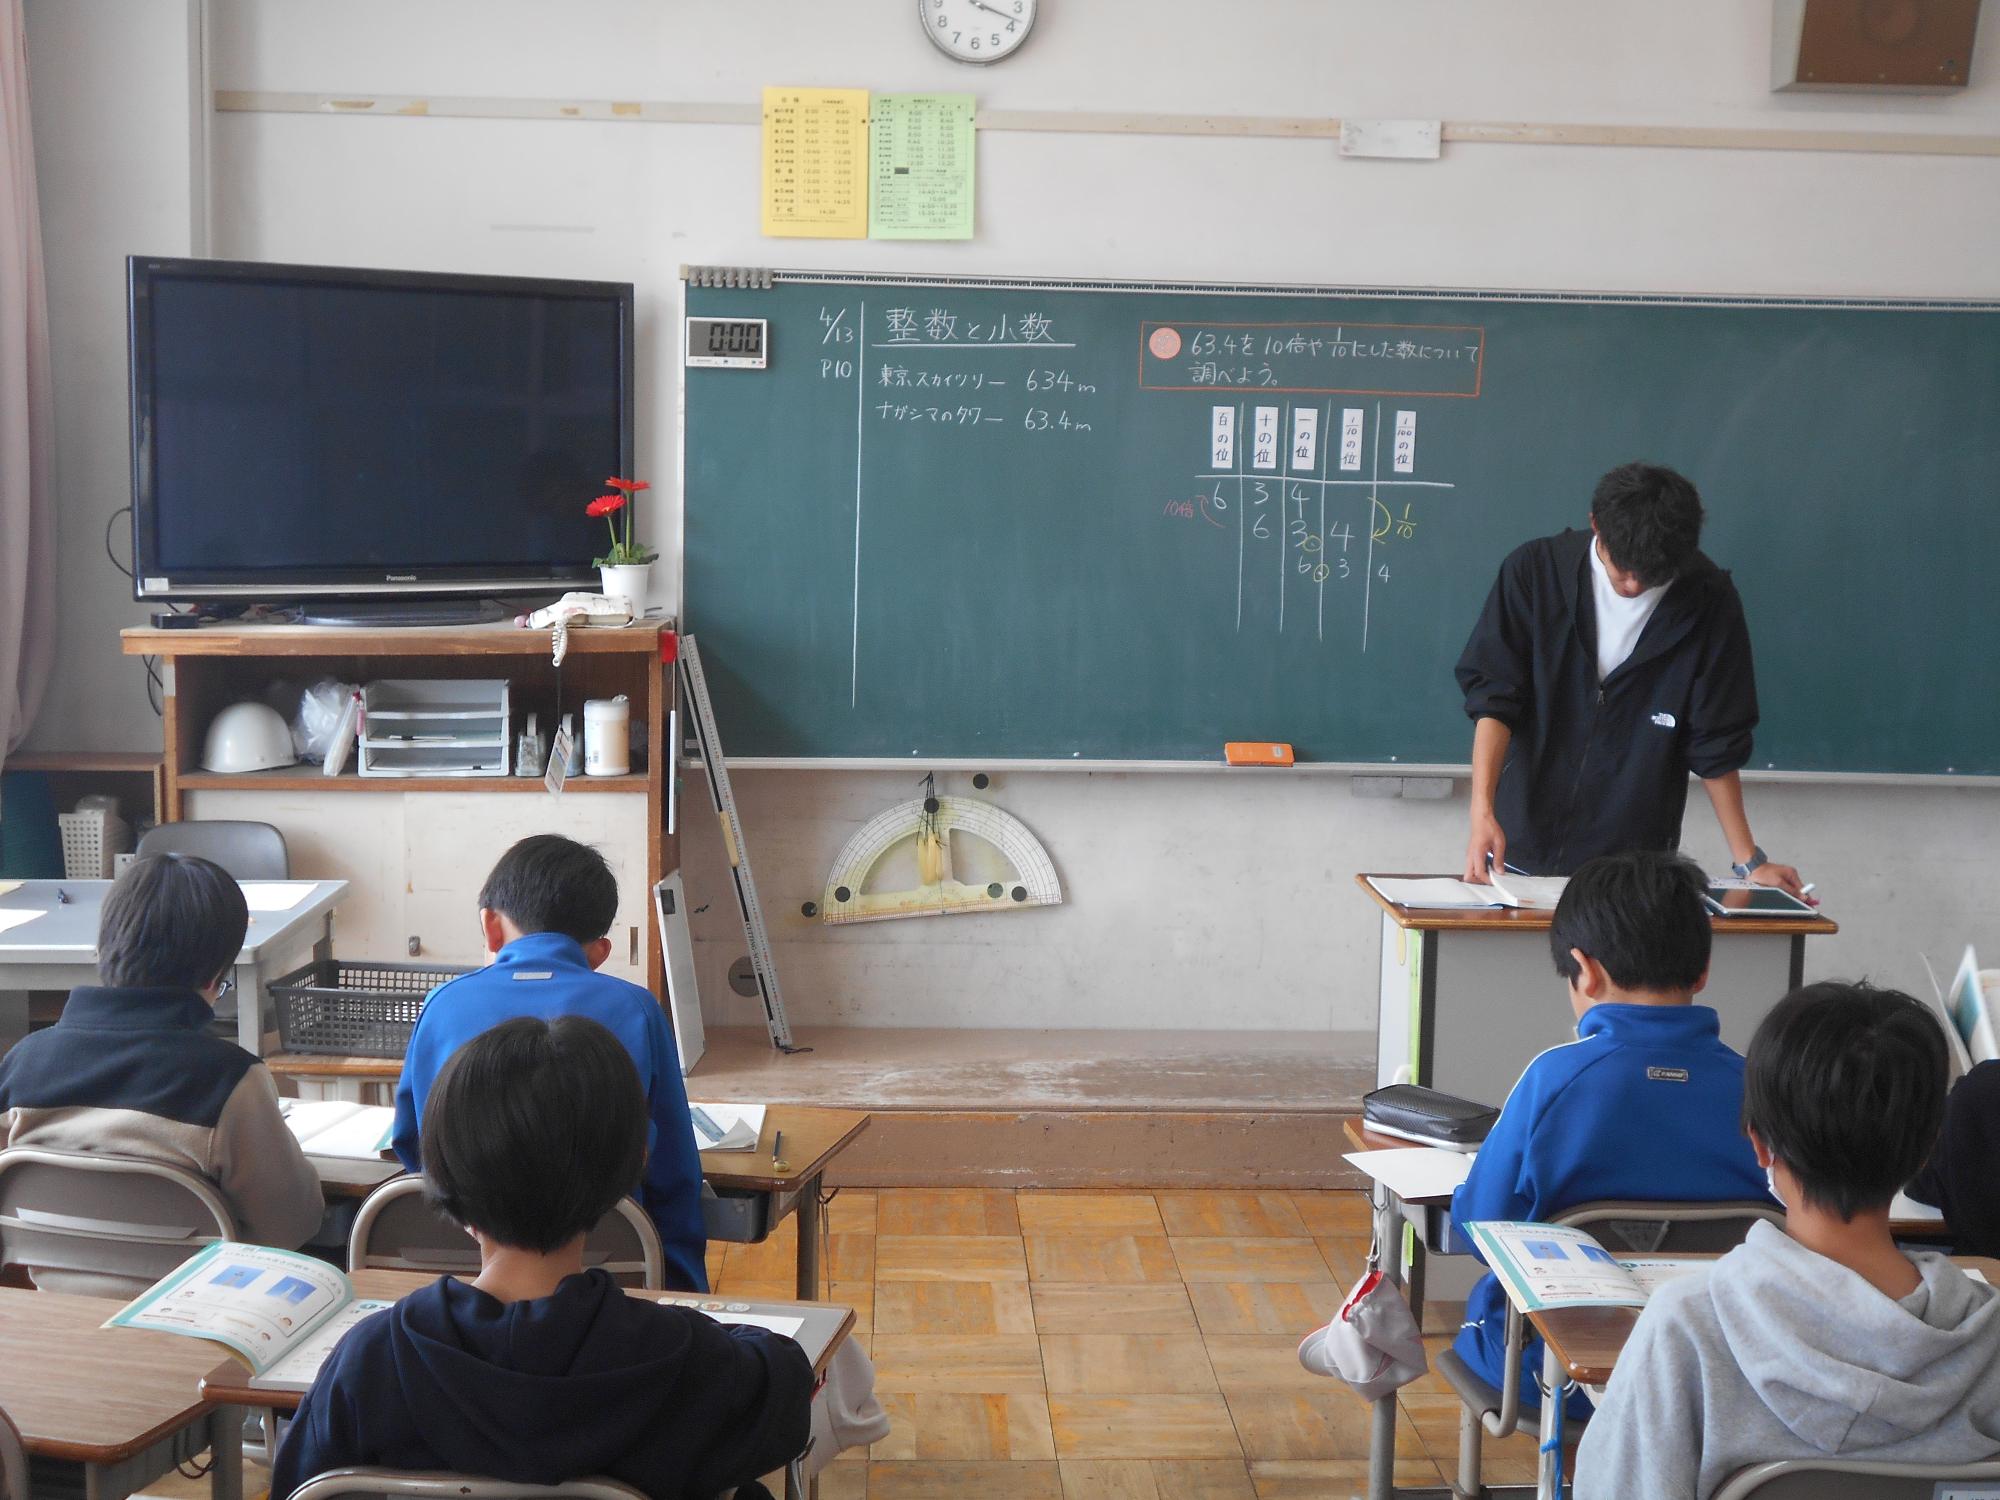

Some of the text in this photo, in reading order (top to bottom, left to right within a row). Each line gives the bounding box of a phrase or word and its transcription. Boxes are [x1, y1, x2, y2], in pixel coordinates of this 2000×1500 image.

[1014, 1, 1023, 13] 3
[938, 15, 947, 27] 8
[1006, 20, 1015, 32] 4
[952, 31, 962, 44] 7
[970, 37, 980, 50] 6
[991, 33, 1000, 46] 5
[886, 307, 1056, 345] 整数と小数
[879, 364, 1006, 388] 東京スカイツリー
[1255, 413, 1273, 463] 十の位
[1213, 481, 1310, 519] 6 3 4
[1253, 513, 1270, 539] 6
[1330, 521, 1355, 552] 4
[1338, 558, 1350, 578] 3
[1378, 564, 1391, 583] 4
